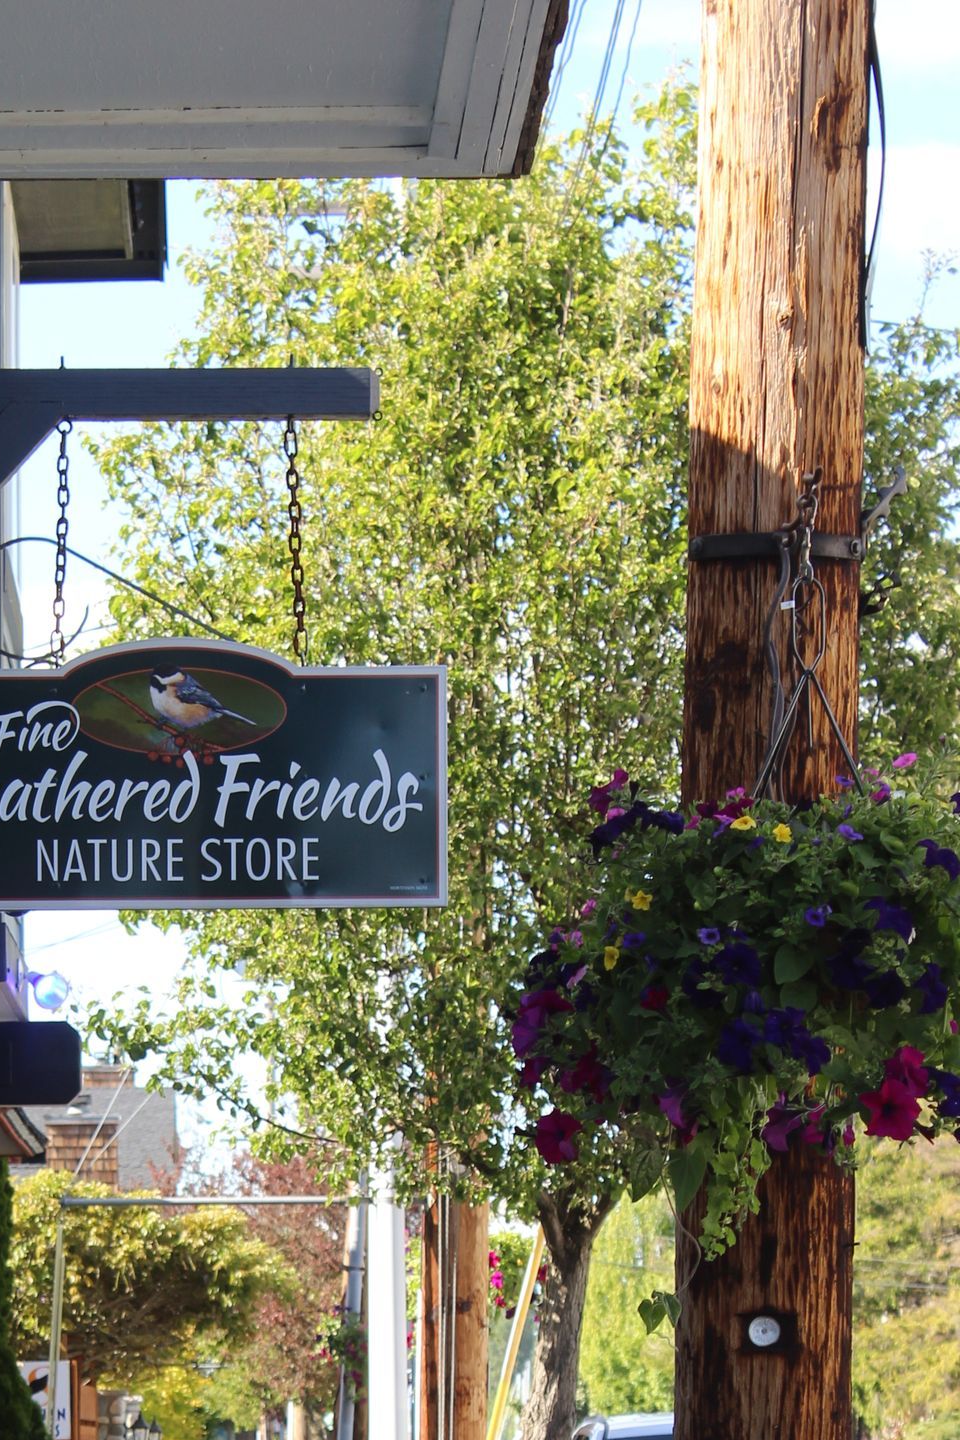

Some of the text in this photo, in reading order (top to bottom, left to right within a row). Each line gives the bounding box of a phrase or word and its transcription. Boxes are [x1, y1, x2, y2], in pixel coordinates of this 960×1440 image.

[214, 748, 423, 832] Friends
[36, 836, 320, 882] NATURE STORE
